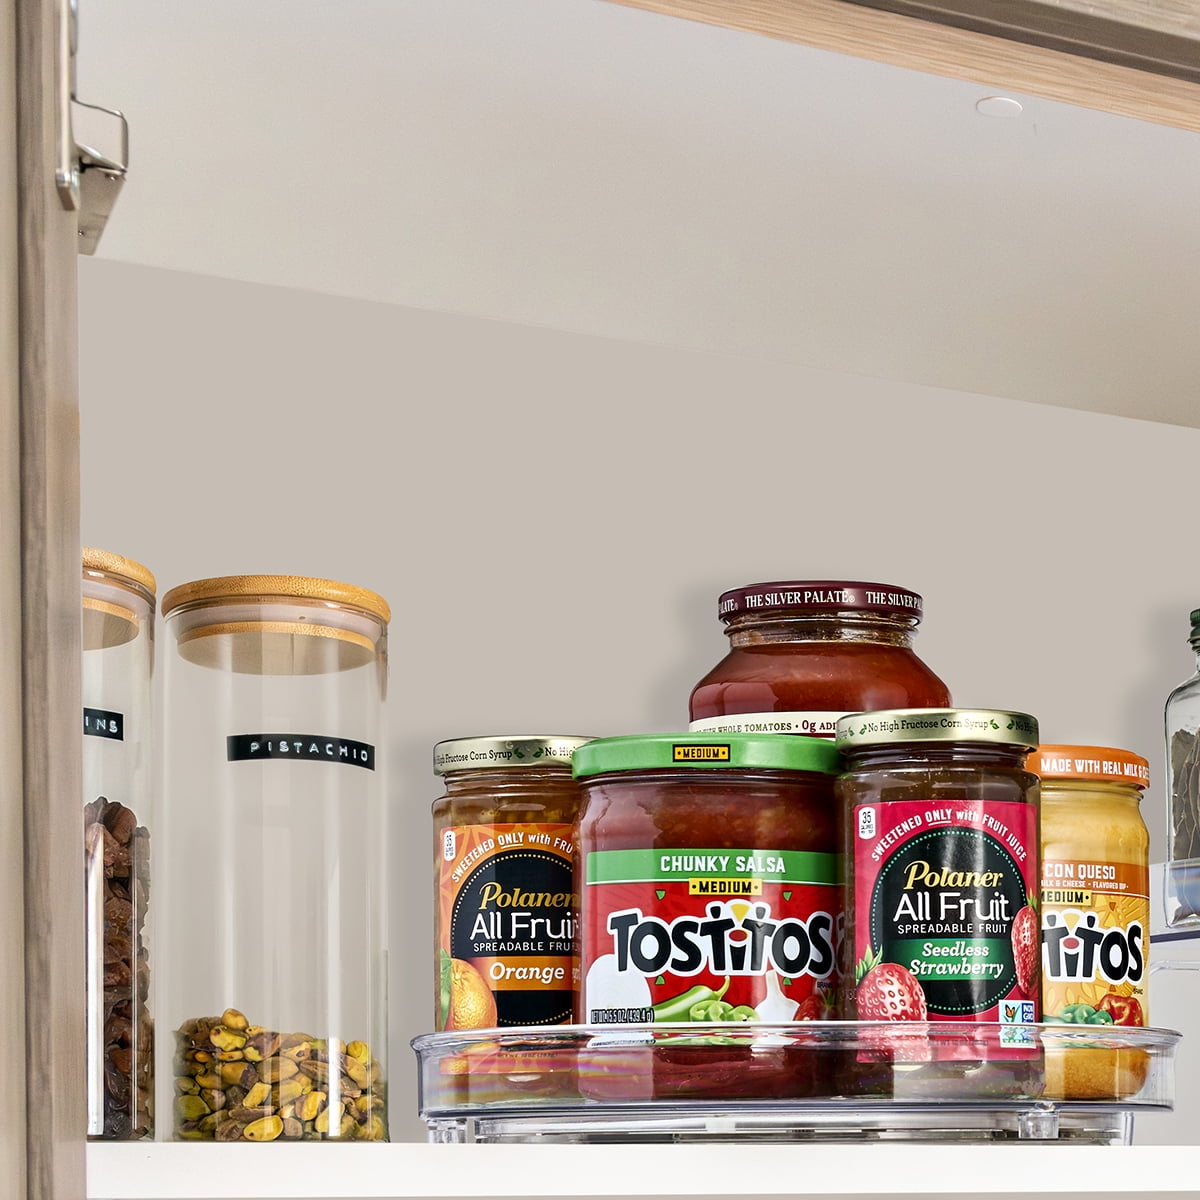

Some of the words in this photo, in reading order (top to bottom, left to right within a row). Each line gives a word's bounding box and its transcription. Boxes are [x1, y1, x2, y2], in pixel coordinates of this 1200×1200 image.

[745, 595, 765, 608] THE
[765, 592, 801, 607] SILVER
[866, 591, 887, 605] THE
[888, 592, 913, 608] SILVER
[745, 722, 792, 733] TOMATOES
[868, 724, 878, 732] No
[880, 721, 899, 732] High
[901, 719, 939, 730] Fructose
[940, 718, 962, 729] Corn
[964, 718, 989, 731] Syrup
[250, 740, 368, 762] PISTACHIO
[445, 753, 469, 764] Fructose
[470, 750, 488, 761] Corn
[489, 749, 513, 761] Syrup
[545, 747, 558, 756] No
[683, 748, 720, 758] MEDIUM
[1041, 758, 1071, 772] MADE
[1075, 759, 1100, 774] WITH
[1103, 761, 1122, 775] REAL
[1124, 763, 1137, 778] MILK
[862, 811, 871, 824] 35
[871, 815, 923, 862] SWEETENED
[925, 808, 953, 822] ONLY
[956, 809, 979, 823] with
[982, 814, 1009, 837] FRUIT
[1006, 834, 1027, 862] JUICE
[451, 838, 495, 882] SWEETENED
[498, 832, 524, 846] ONLY
[528, 832, 551, 845] with
[553, 838, 574, 854] FRU
[660, 855, 730, 872] CHUNKY
[735, 856, 786, 873] SALSA
[903, 860, 1003, 890] Polaner
[1044, 863, 1074, 878] CON
[1078, 864, 1115, 880] QUESO
[699, 881, 752, 893] MEDIUM
[1062, 880, 1085, 888] CHEESE
[1093, 881, 1118, 889] FLAVORED
[893, 891, 931, 922] All
[469, 911, 502, 940] All
[898, 923, 973, 934] SPREADABLE
[979, 923, 1007, 933] FRUIT
[473, 942, 543, 952] SPREADABLE
[921, 942, 989, 957] Seedless
[489, 962, 565, 984] Orange
[910, 958, 1004, 979] Strawberry
